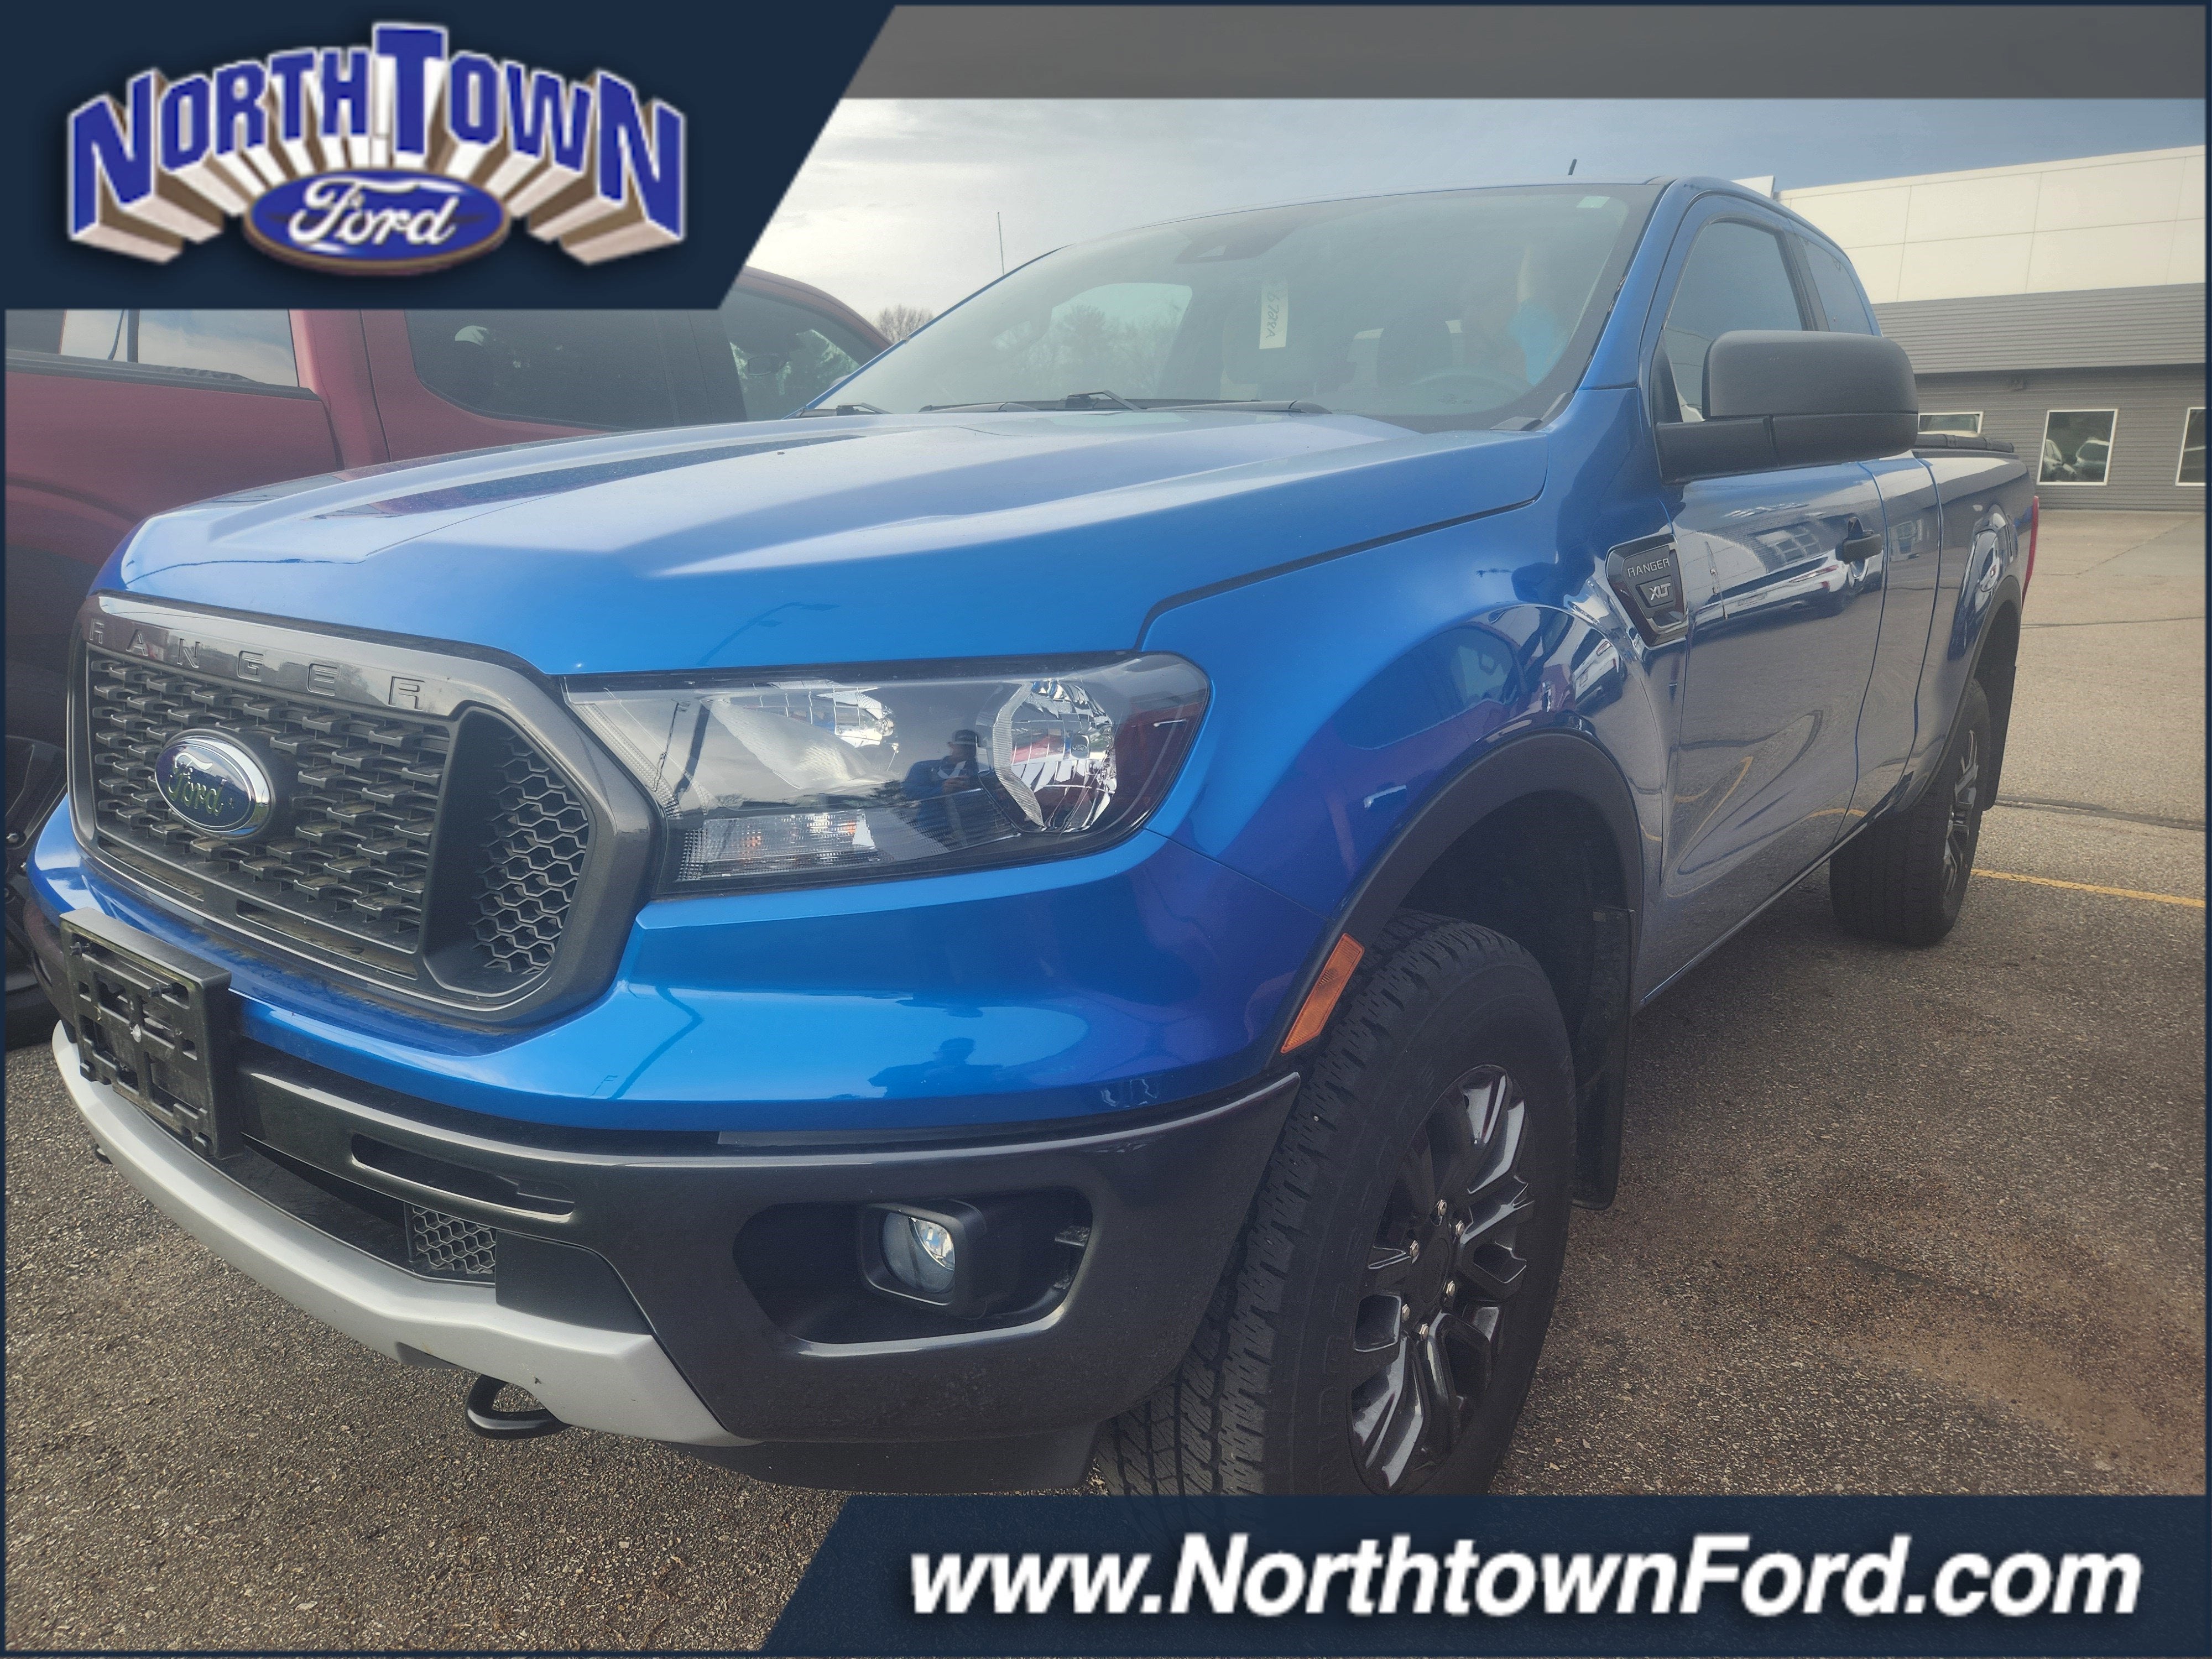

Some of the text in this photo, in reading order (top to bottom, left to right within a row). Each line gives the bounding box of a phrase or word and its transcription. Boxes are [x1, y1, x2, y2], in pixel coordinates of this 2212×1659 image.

[1627, 558, 1670, 577] RANGER
[1649, 583, 1671, 601] XLT
[88, 617, 425, 709] RANGER
[168, 751, 228, 816] Ford
